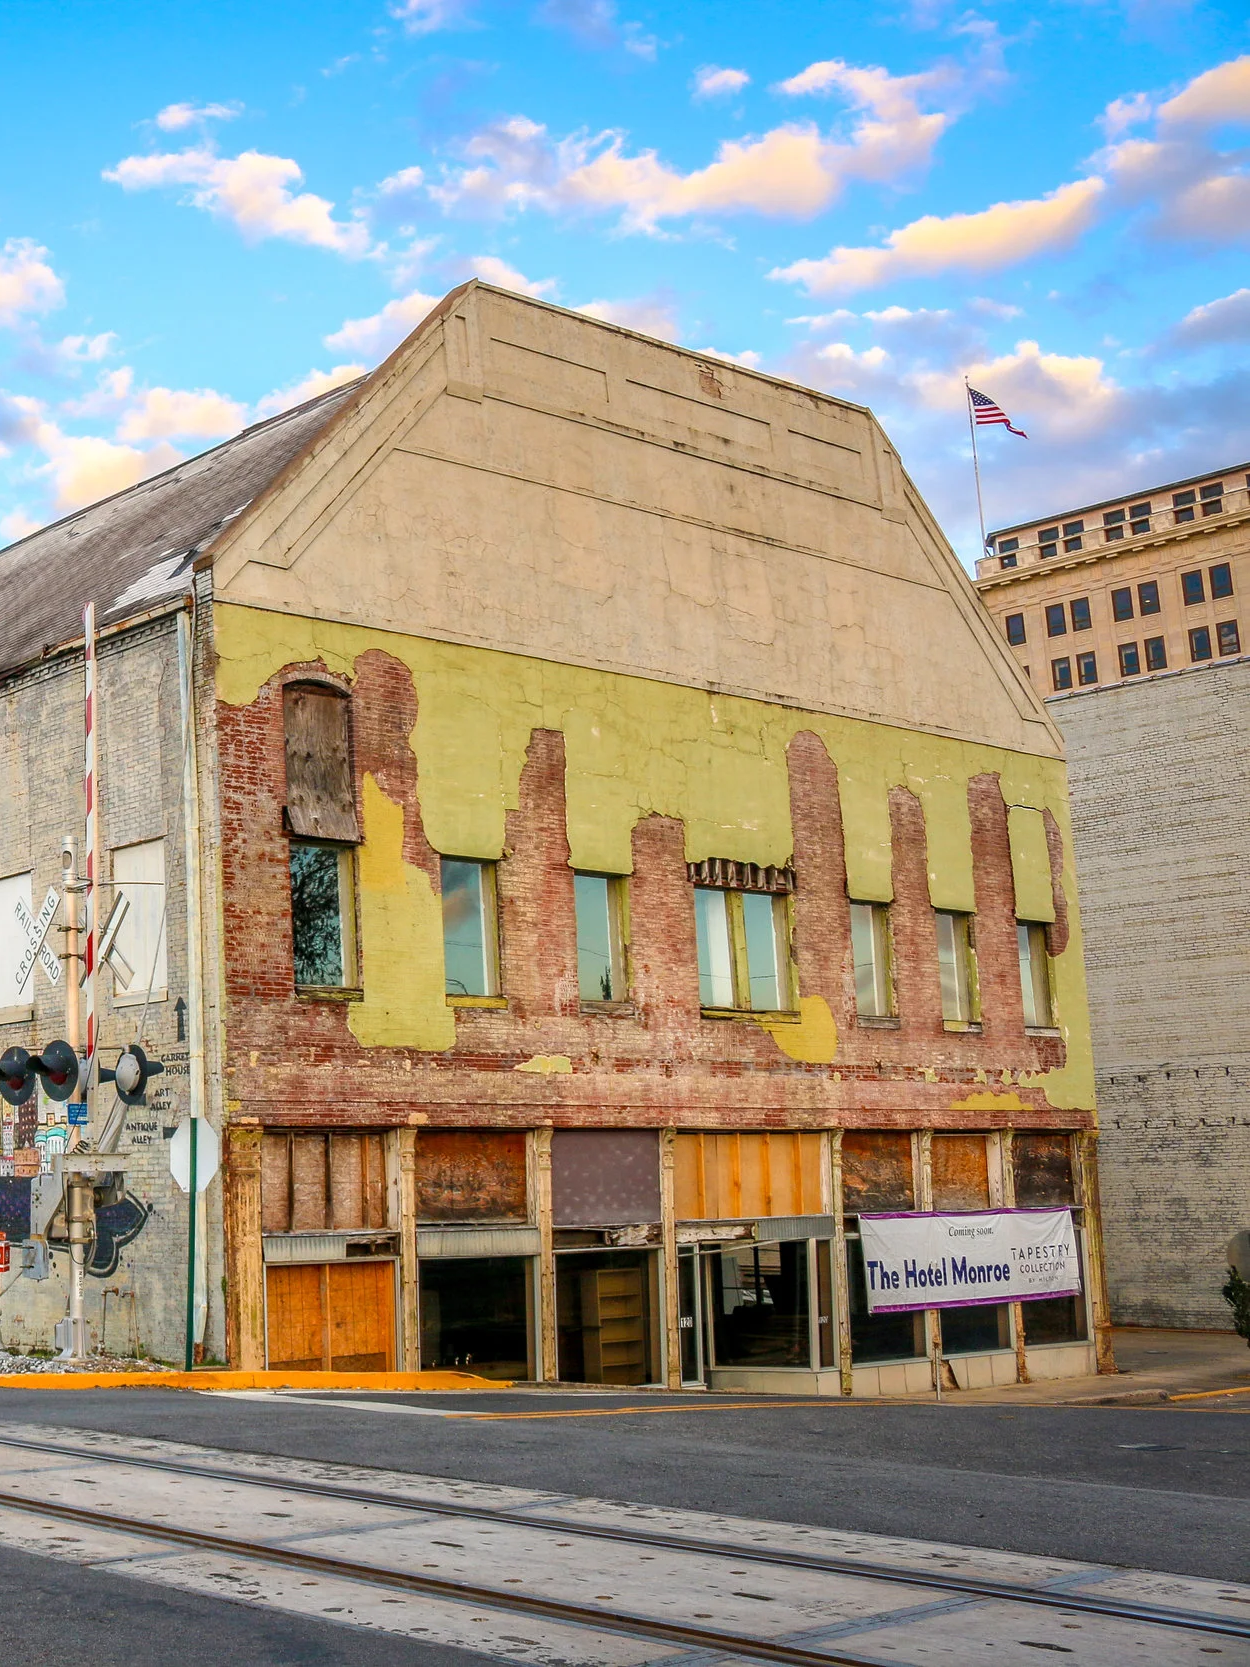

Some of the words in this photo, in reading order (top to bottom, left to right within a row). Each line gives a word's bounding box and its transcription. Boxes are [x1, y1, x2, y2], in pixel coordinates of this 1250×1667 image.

[14, 902, 32, 937] RAIL
[39, 944, 60, 980] ROAD
[15, 895, 55, 984] CROSSING
[165, 1065, 190, 1076] HOUSE
[154, 1087, 170, 1097] ART
[150, 1101, 171, 1111] ALLEY
[125, 1121, 158, 1131] ANTIQUE
[132, 1135, 152, 1144] ALLEY
[948, 1226, 975, 1239] Coming
[976, 1226, 994, 1236] soon.
[1011, 1243, 1070, 1260] TAPESTRY
[866, 1260, 900, 1290] The
[903, 1257, 947, 1288] Hotel
[951, 1255, 1010, 1285] Monroe
[1019, 1261, 1066, 1273] COLLECTION
